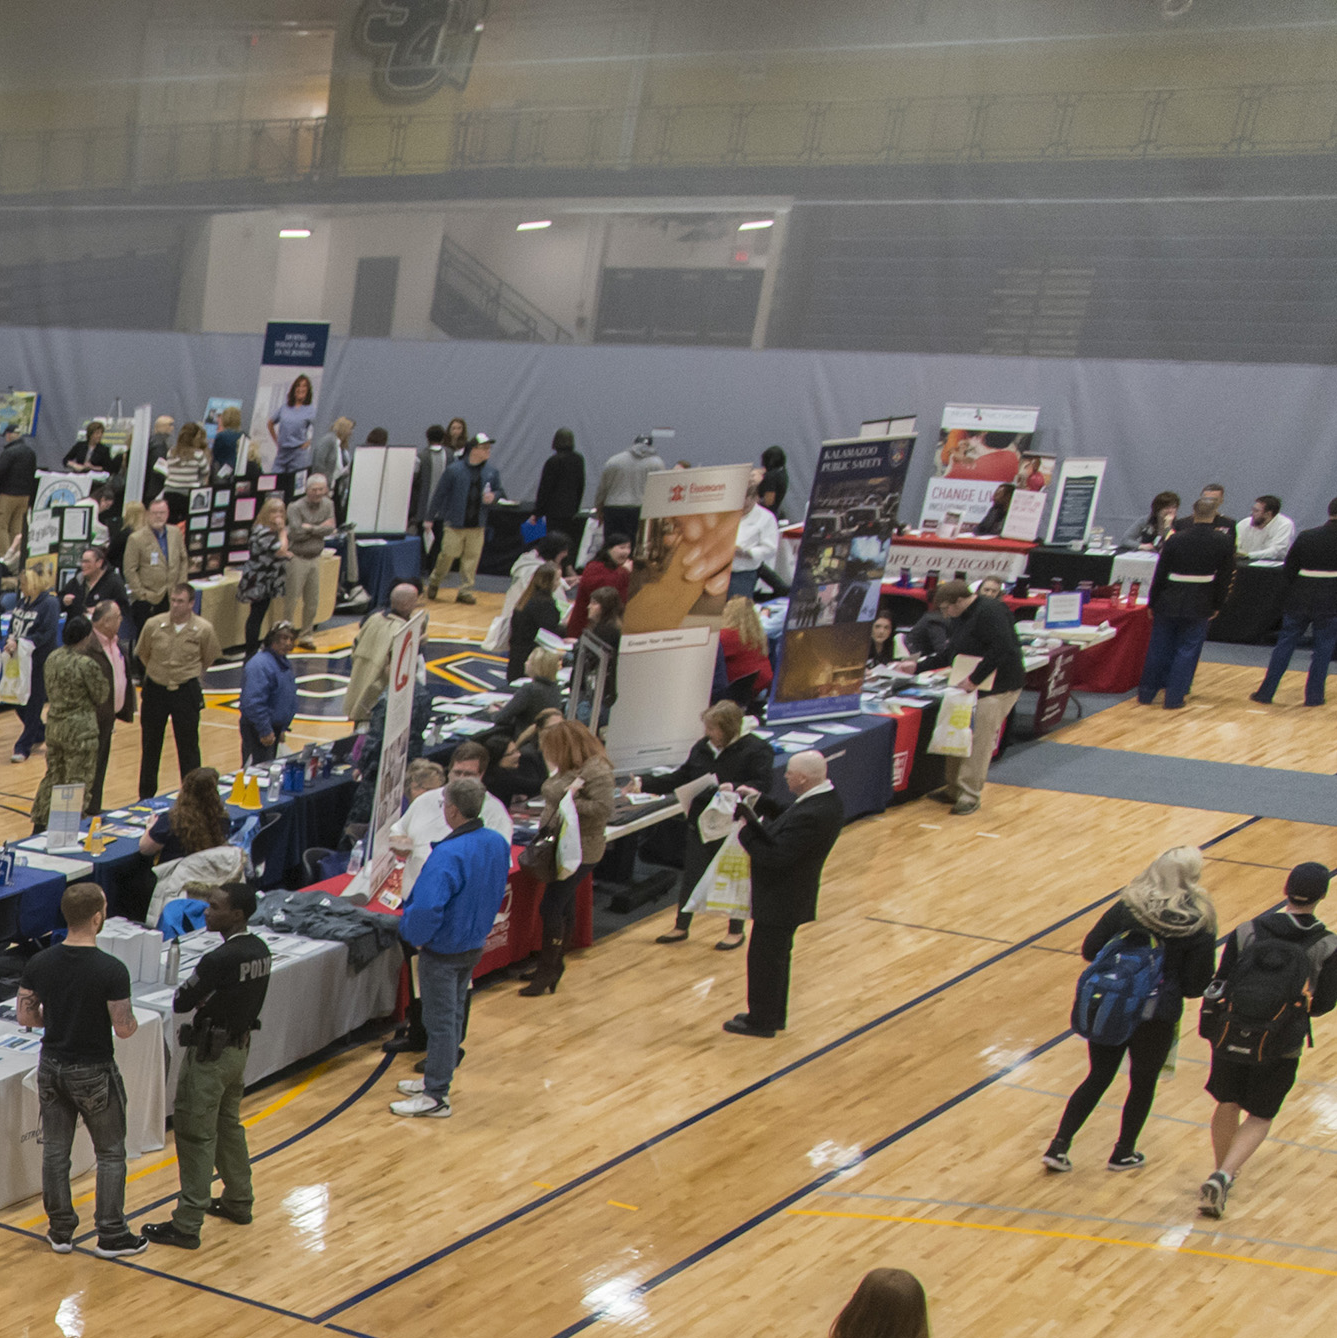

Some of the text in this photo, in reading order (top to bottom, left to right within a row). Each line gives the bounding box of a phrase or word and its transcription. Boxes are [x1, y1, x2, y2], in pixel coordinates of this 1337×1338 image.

[824, 446, 878, 460] KALAMAZOO
[821, 457, 882, 472] PUBLIC SAFETY
[931, 486, 976, 501] CHANGE
[926, 555, 1013, 572] OVERCOME
